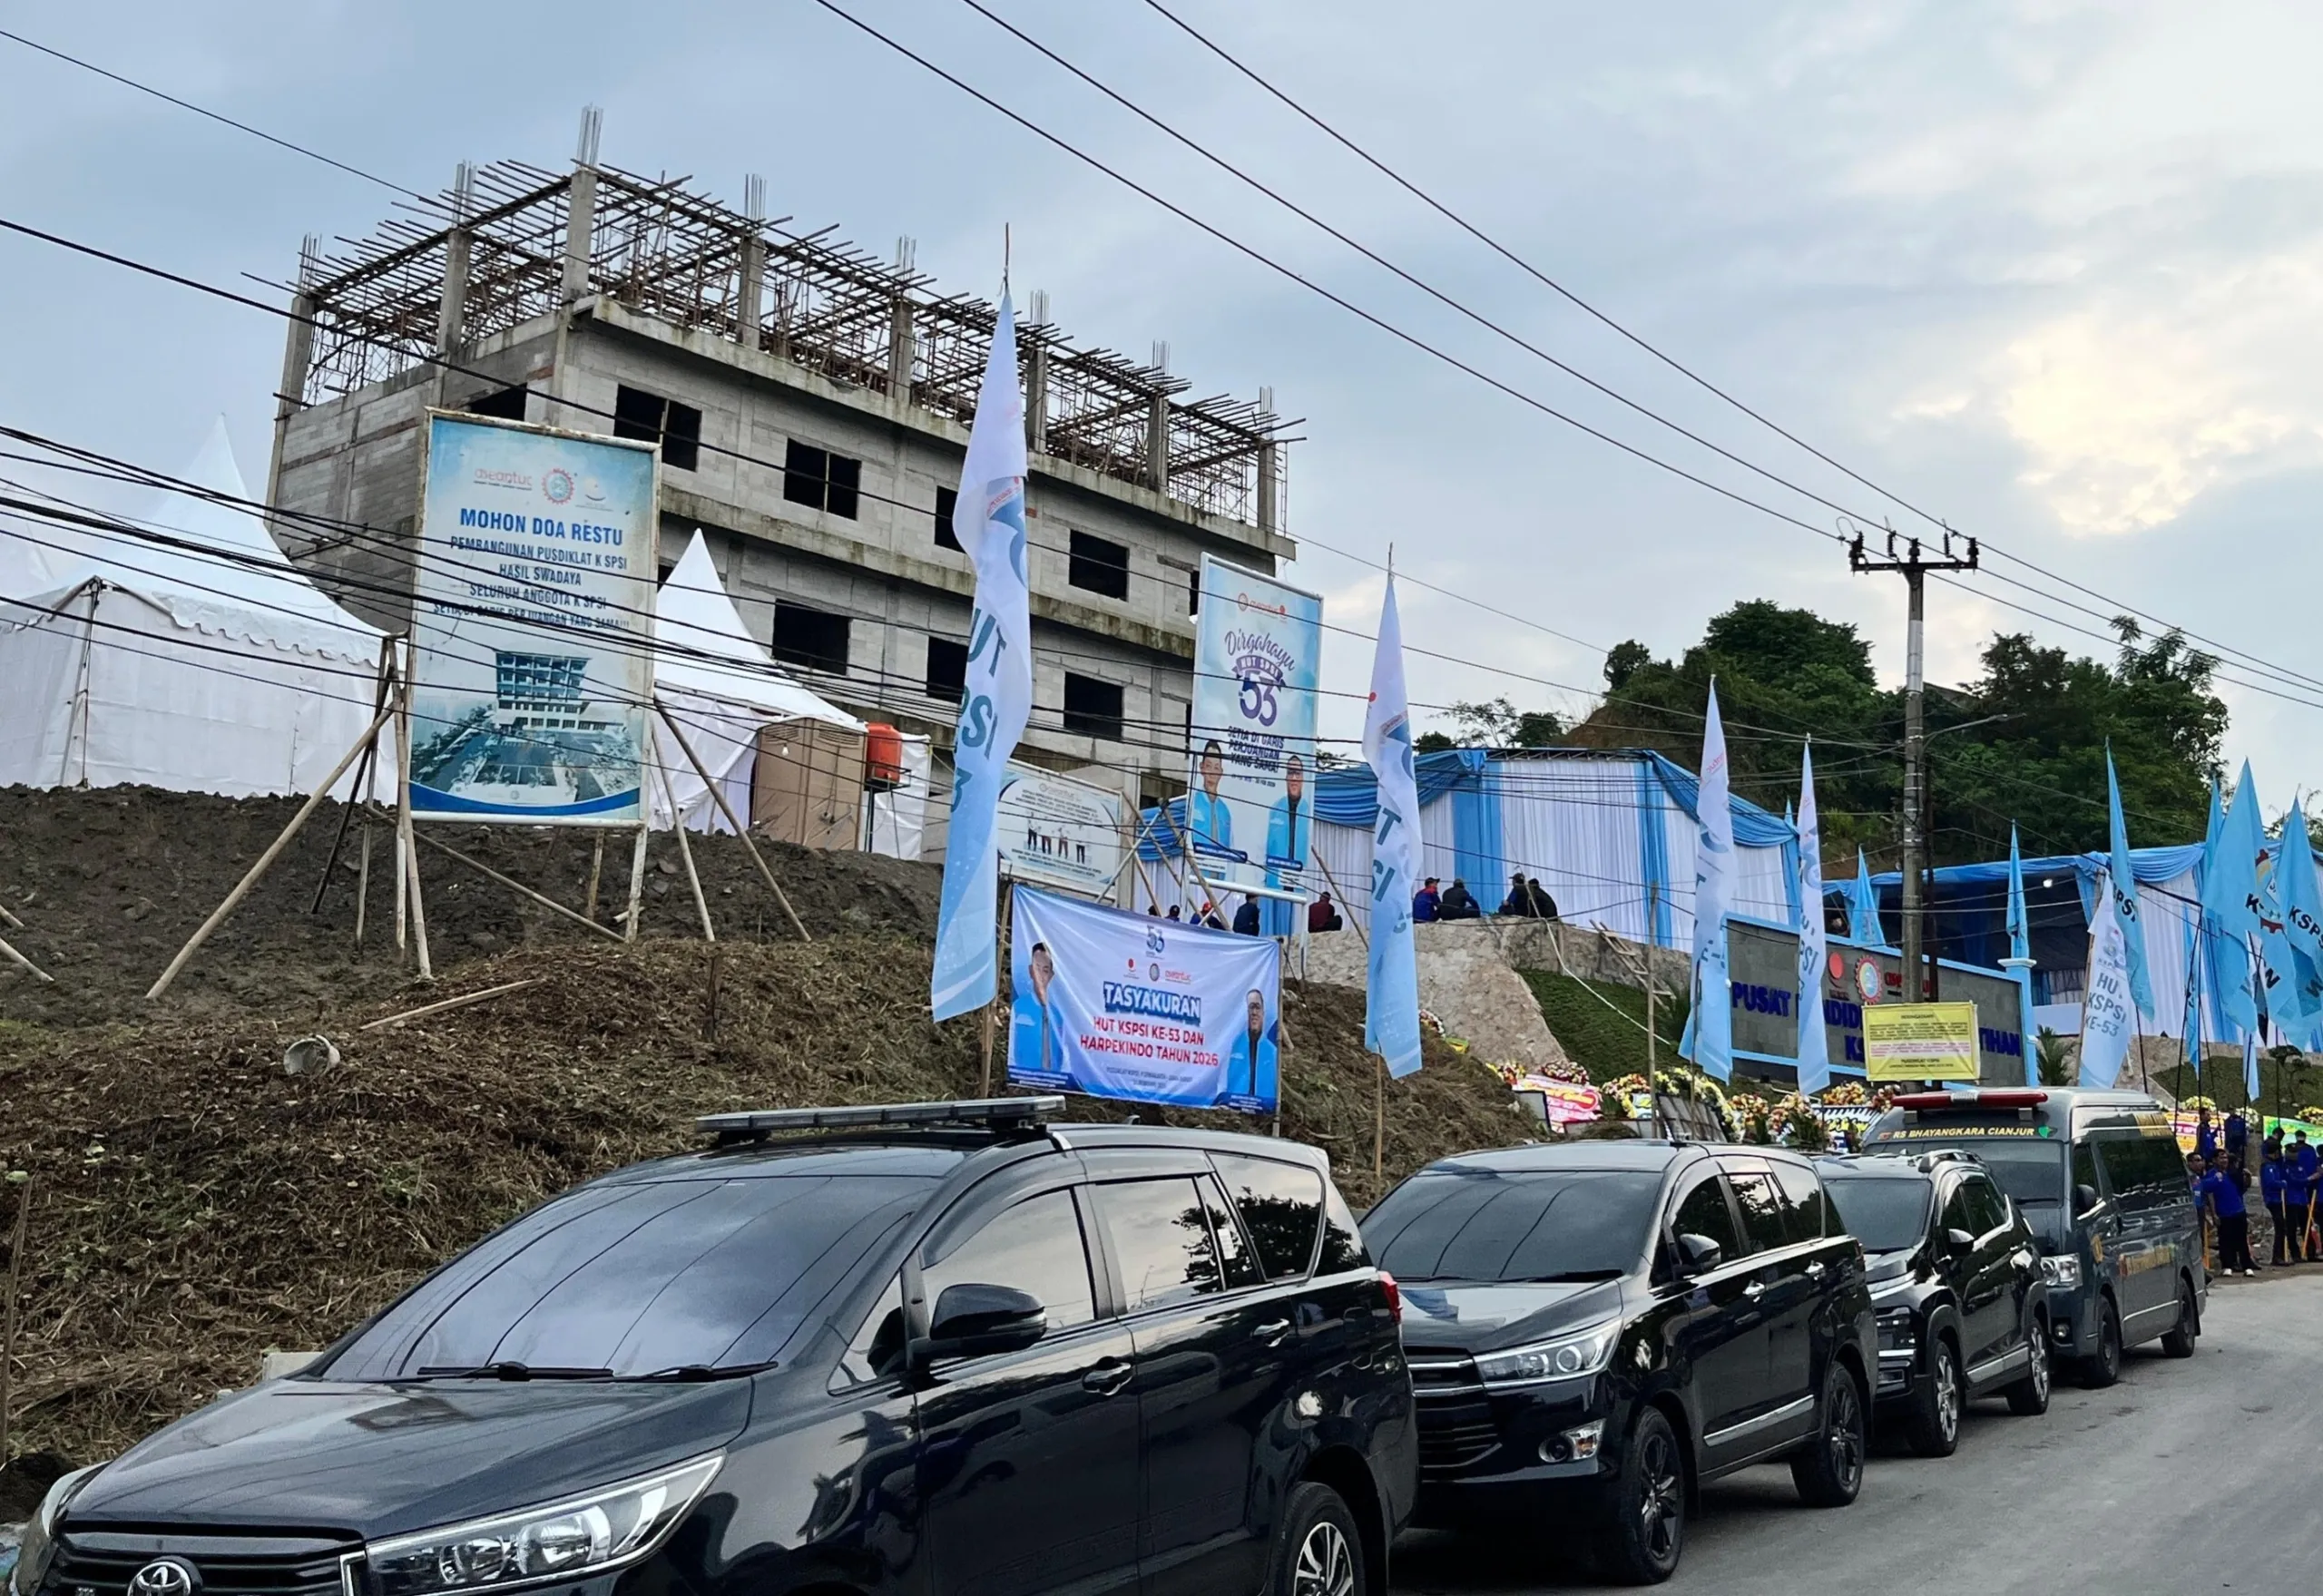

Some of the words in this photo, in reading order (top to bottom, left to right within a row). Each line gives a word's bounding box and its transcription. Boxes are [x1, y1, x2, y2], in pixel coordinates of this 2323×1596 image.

[460, 508, 526, 534] MOHON
[533, 518, 566, 539] DOA
[572, 524, 623, 546] RESTU
[450, 536, 534, 559] PEMBANGUNAN
[537, 546, 593, 565] PUSDIKLAT
[595, 553, 603, 567] K
[604, 554, 628, 570] SPSI
[499, 563, 531, 580] HASIL
[534, 566, 582, 586] SWADAYA
[470, 583, 520, 600] SELURUH
[524, 588, 571, 606] ANGGOTA
[1224, 628, 1296, 672] Dirgahayu
[1240, 671, 1278, 727] 53
[1103, 982, 1201, 1022] TASYAKURAN
[1731, 982, 1791, 1017] PUSAT
[1093, 1016, 1115, 1033] HUT
[1118, 1020, 1150, 1039] KSPSI
[1152, 1024, 1181, 1043] KE-53
[1182, 1031, 1205, 1046] DAN
[1080, 1034, 1154, 1058] HARPEKINDO
[1157, 1045, 1191, 1063] TAHUN
[1192, 1050, 1220, 1067] 2026
[1892, 1130, 1906, 1139] RS
[1907, 1127, 1985, 1139] BHAYANGKARA
[1987, 1126, 2034, 1137] CIANJUR
